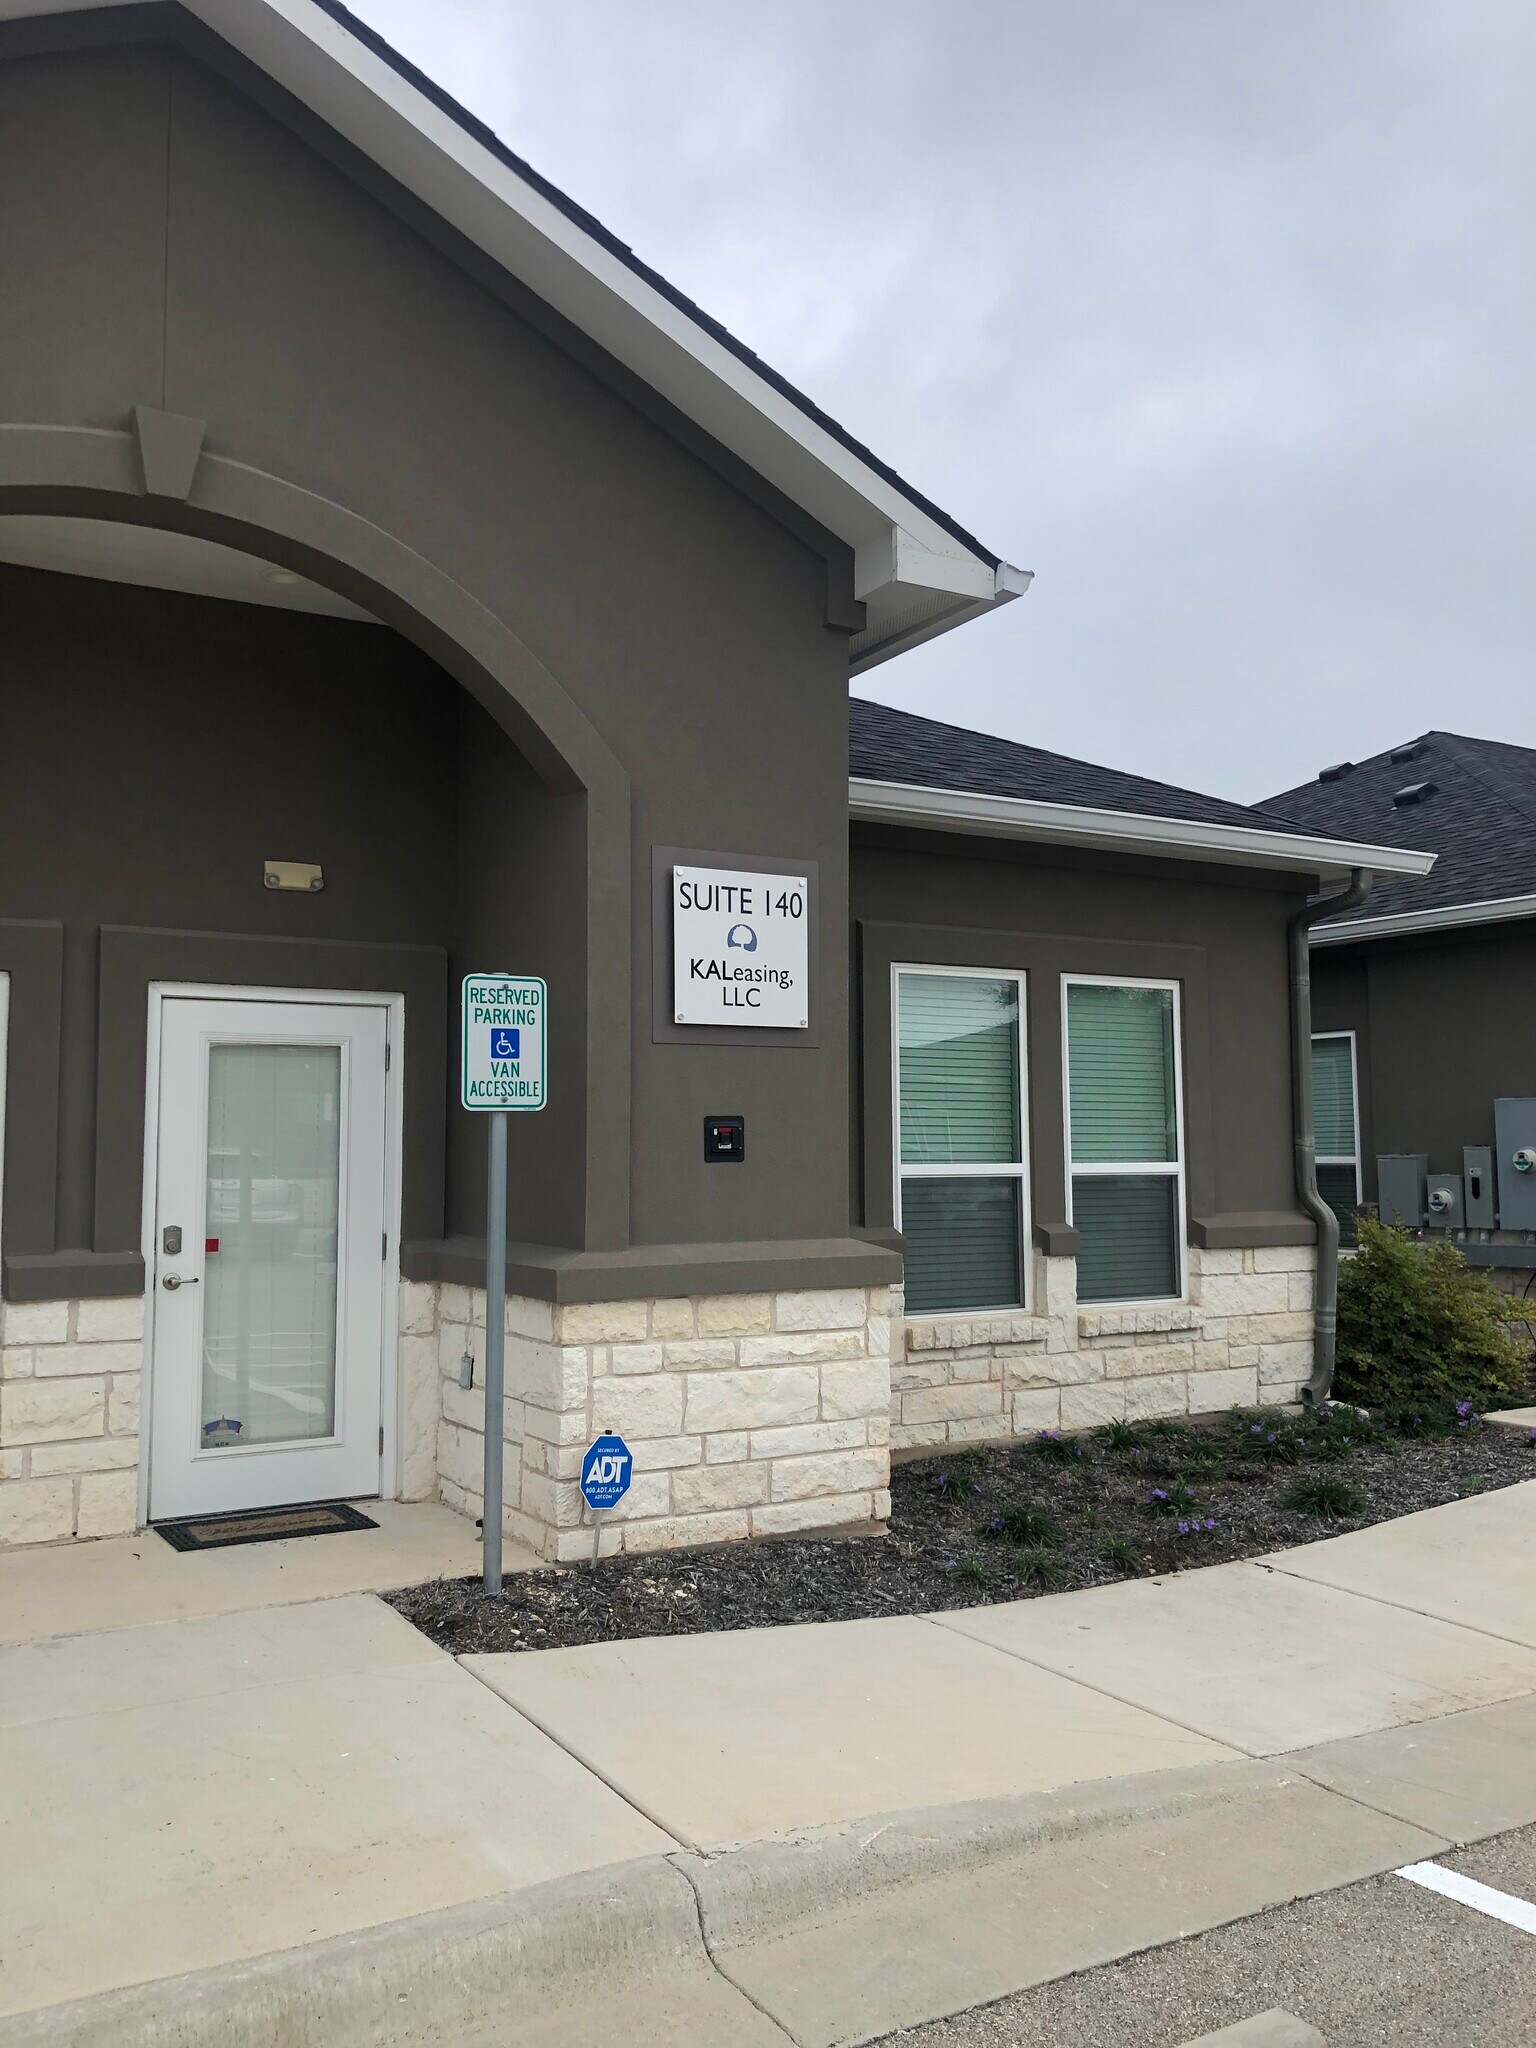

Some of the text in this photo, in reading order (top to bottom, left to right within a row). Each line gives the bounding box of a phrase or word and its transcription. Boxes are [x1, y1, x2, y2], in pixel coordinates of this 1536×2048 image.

[679, 882, 803, 919] SUITE 140
[690, 958, 794, 990] KALeasing,
[470, 987, 540, 1006] RESERVED
[723, 986, 761, 1007] LLC
[474, 1007, 536, 1026] PARKING
[490, 1061, 520, 1078] VAN
[469, 1080, 540, 1097] ACCESSIBLE
[585, 1456, 629, 1484] ADT
